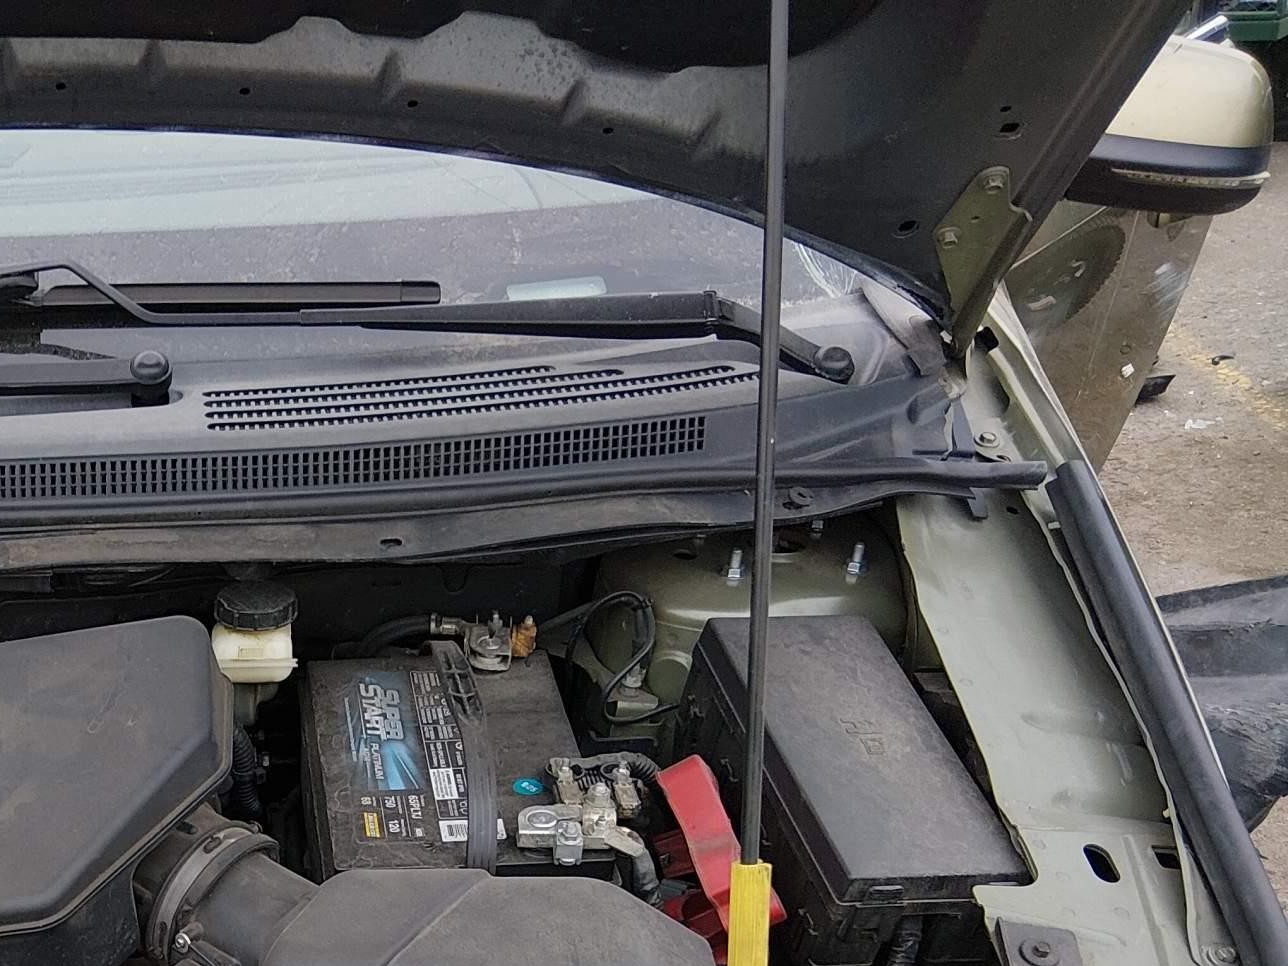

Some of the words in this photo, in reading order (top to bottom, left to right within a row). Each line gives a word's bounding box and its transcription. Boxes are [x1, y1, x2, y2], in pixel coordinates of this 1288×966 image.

[359, 683, 388, 741] START
[383, 689, 404, 740] SUPER
[370, 742, 385, 780] PLATINUM
[388, 820, 401, 833] 120
